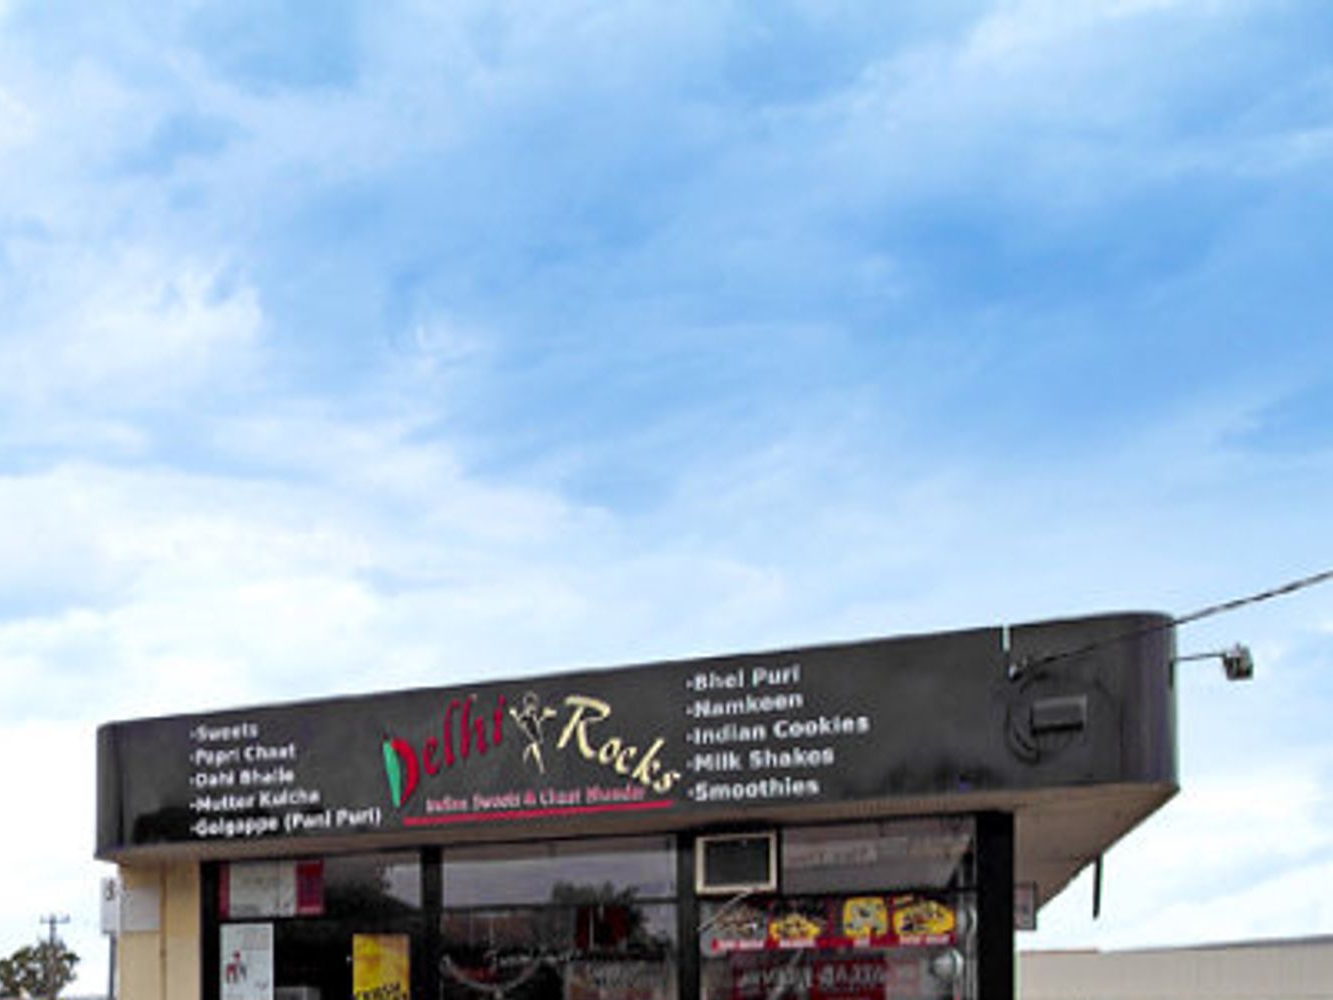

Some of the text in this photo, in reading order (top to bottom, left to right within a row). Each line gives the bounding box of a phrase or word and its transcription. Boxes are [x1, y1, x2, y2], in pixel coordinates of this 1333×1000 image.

[752, 663, 801, 687] Puri
[695, 692, 804, 718] Namkeen
[196, 722, 258, 742] Sweets
[695, 716, 870, 745] Indian Cookies
[381, 693, 506, 809] Delhi
[556, 695, 681, 794] Rocks
[695, 747, 835, 772] Milk Shakes
[695, 776, 820, 801] Smoothies
